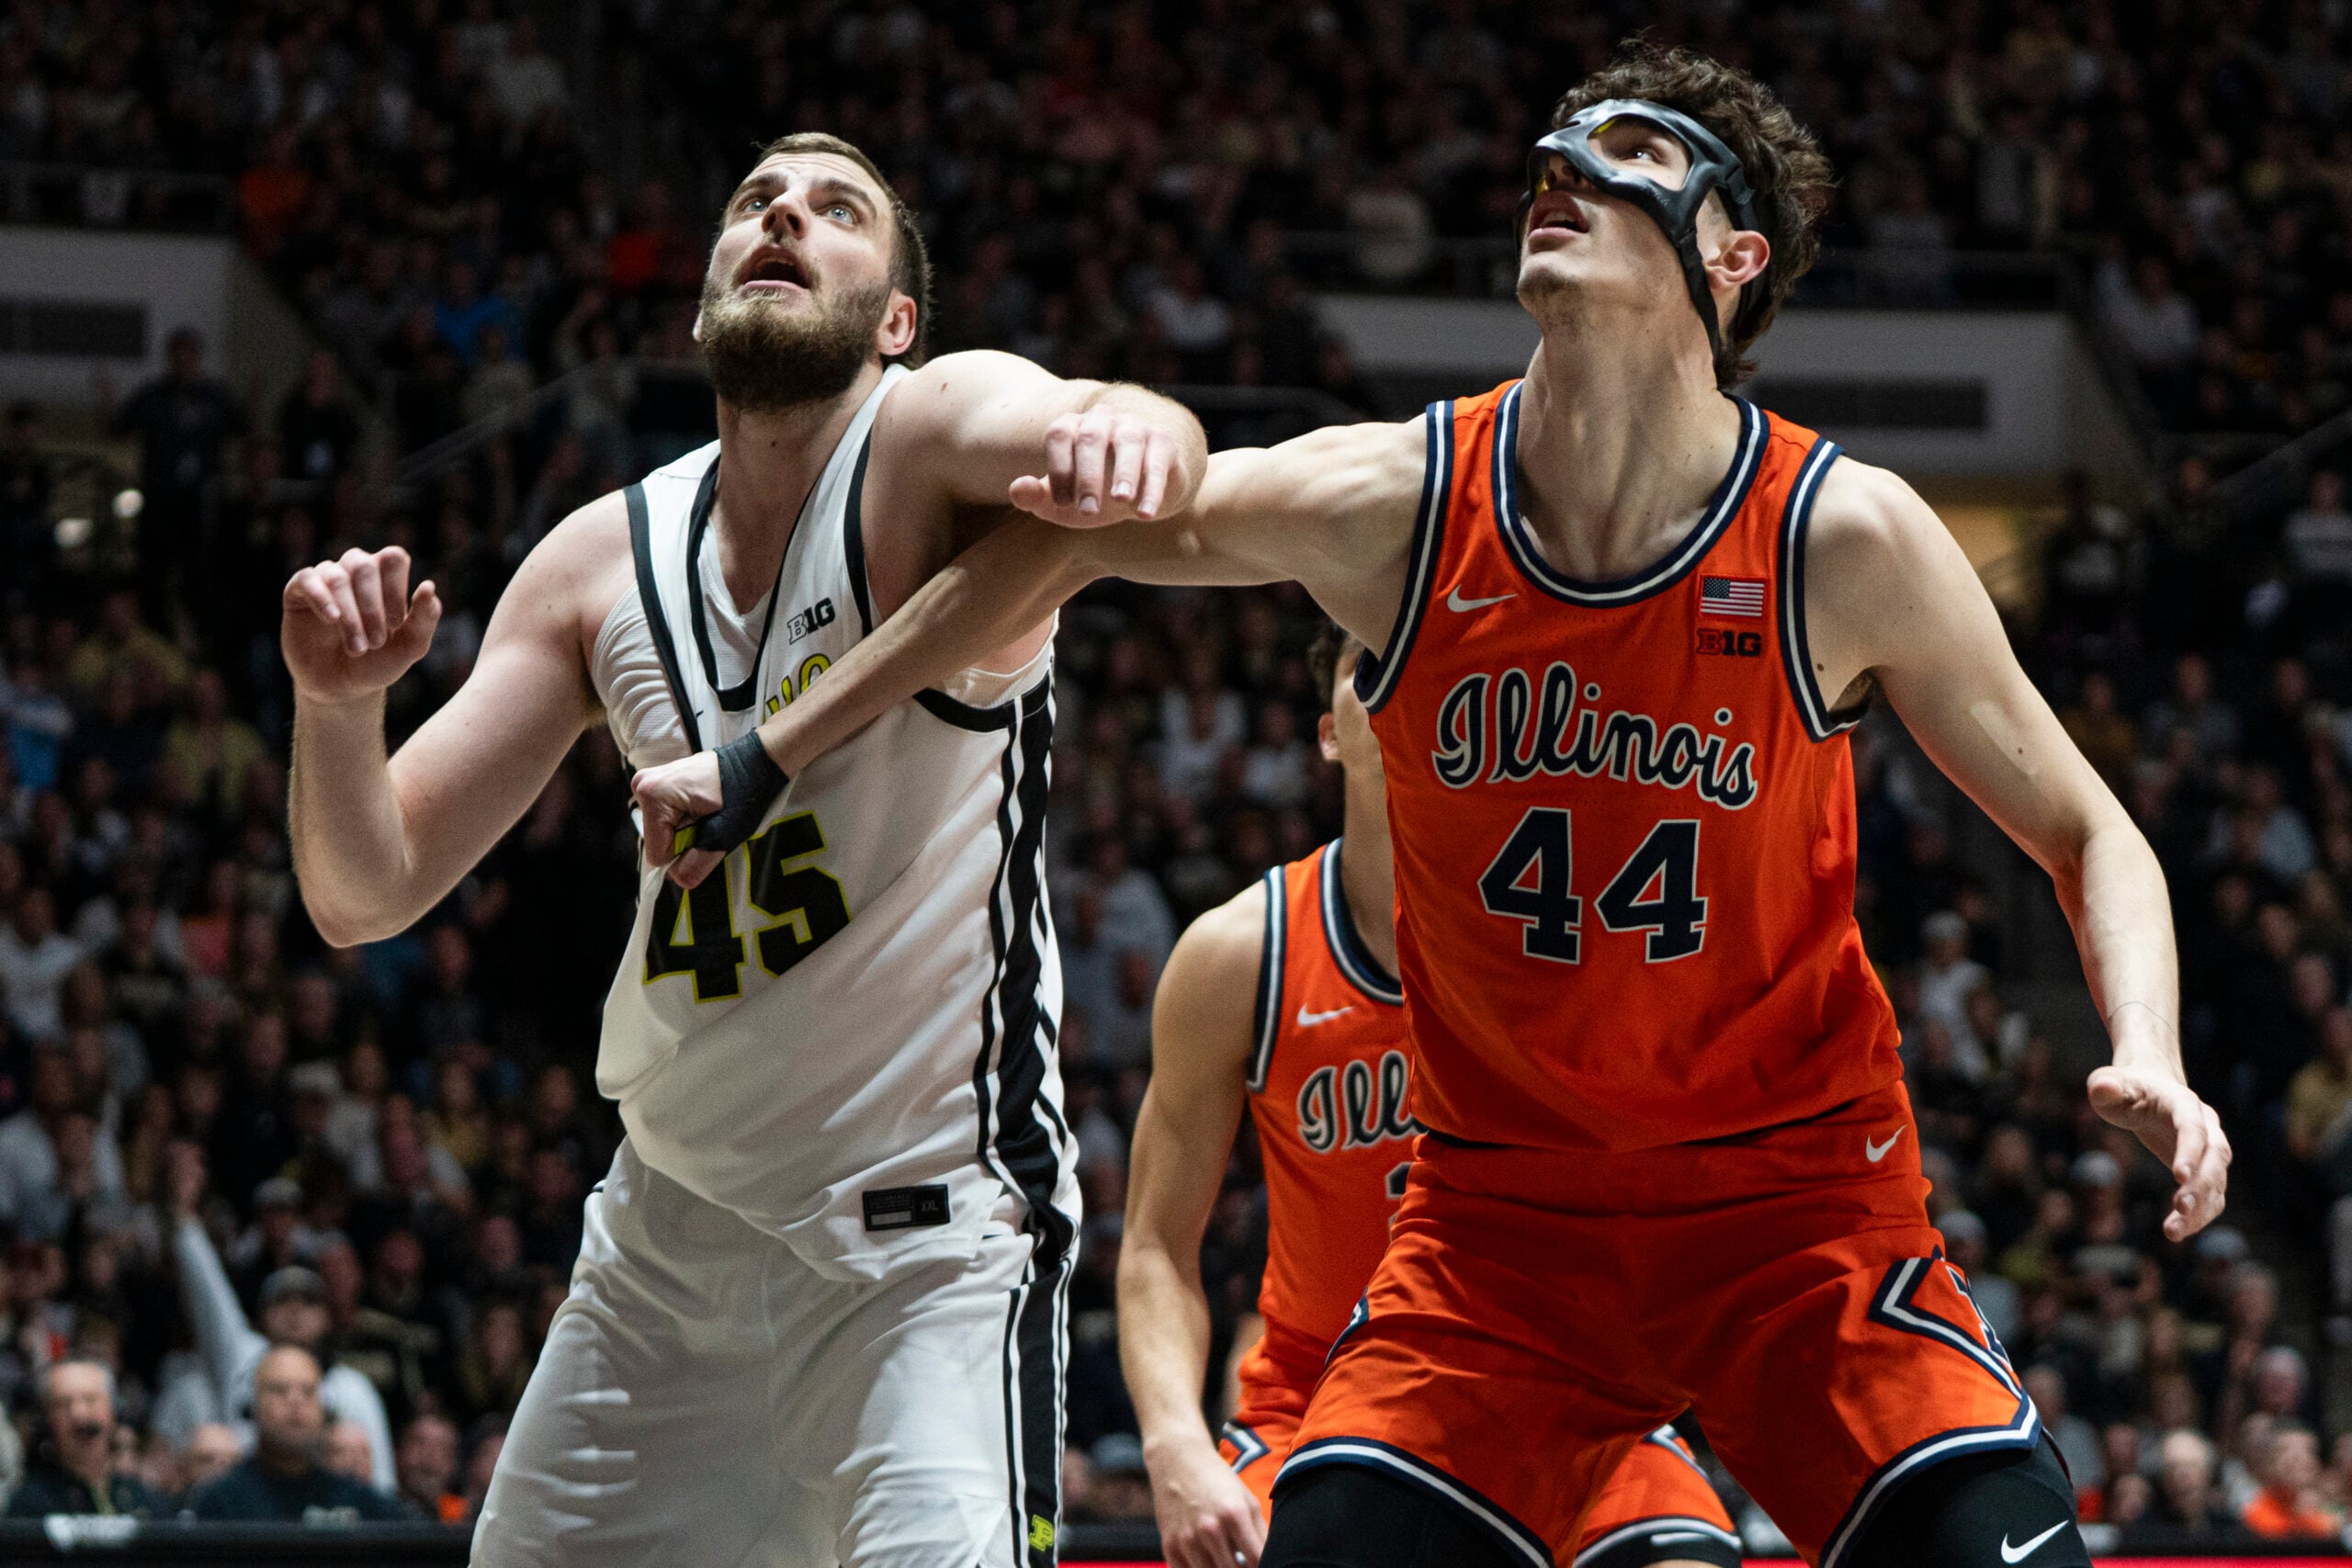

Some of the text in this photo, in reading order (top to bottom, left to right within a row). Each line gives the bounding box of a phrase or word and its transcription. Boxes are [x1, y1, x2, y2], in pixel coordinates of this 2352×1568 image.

[1431, 660, 1758, 810] Illinois
[643, 810, 854, 1005] 45
[1477, 807, 1709, 965] 44
[1297, 1049, 1430, 1155] Ill
